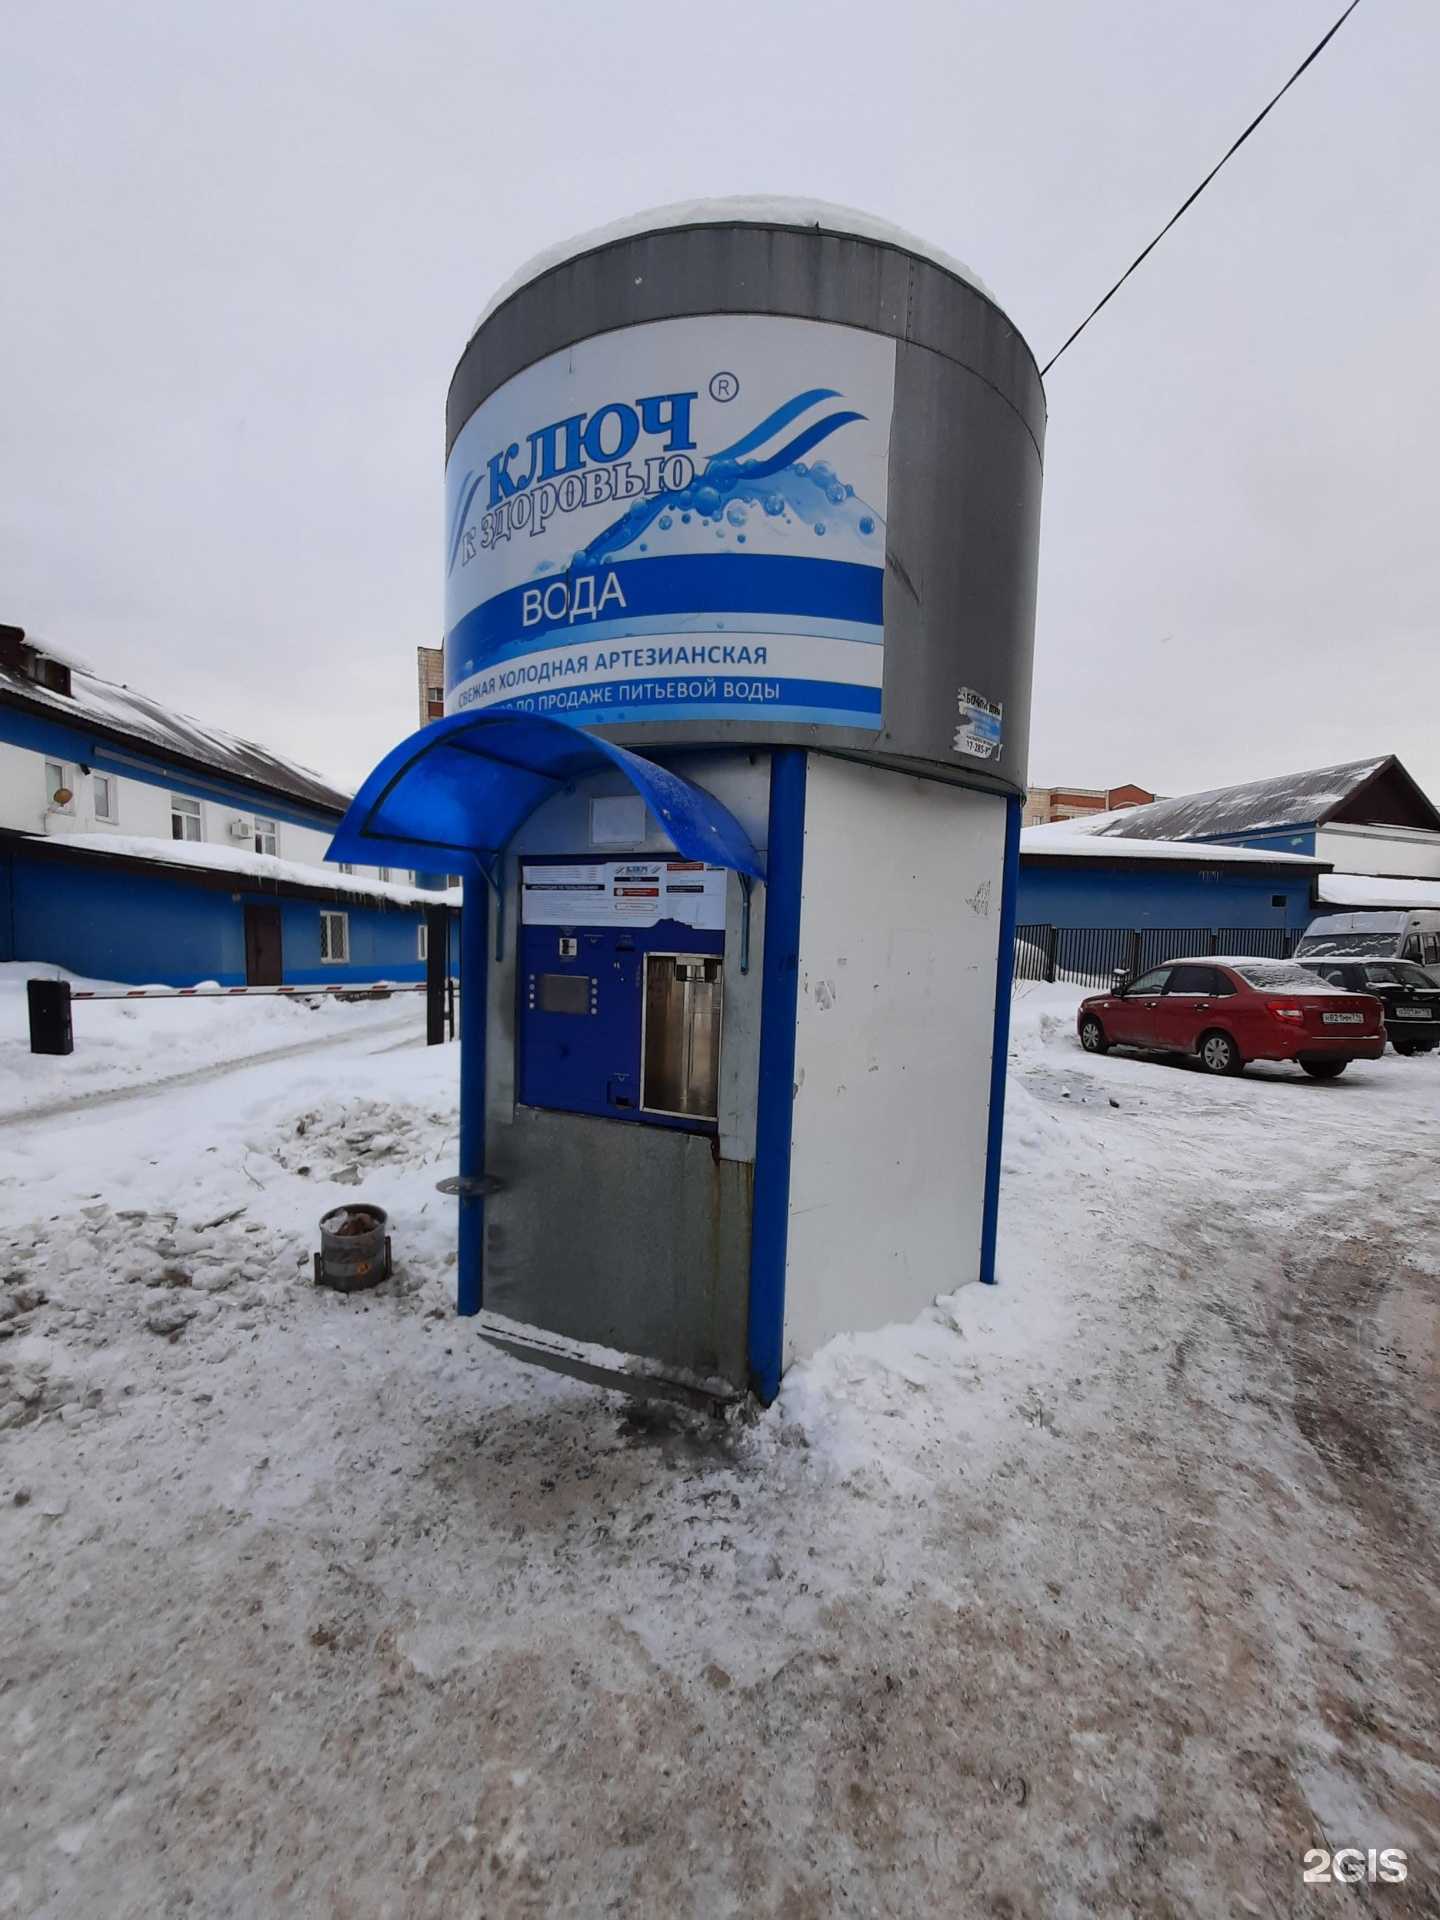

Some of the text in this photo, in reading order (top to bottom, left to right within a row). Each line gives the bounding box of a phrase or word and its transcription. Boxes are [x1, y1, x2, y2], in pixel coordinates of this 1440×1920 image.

[486, 391, 698, 511] КЛЮЧ
[522, 572, 627, 627] ВОДА
[458, 646, 767, 709] СВЕЖАЯ ХОЛОДНАЯ АРТЕЗИАНСКАЯ
[538, 686, 613, 712] ПРОДАЖЕ
[618, 678, 717, 701] ПИТЬЕВОЙ
[723, 682, 780, 702] ВОДЫ
